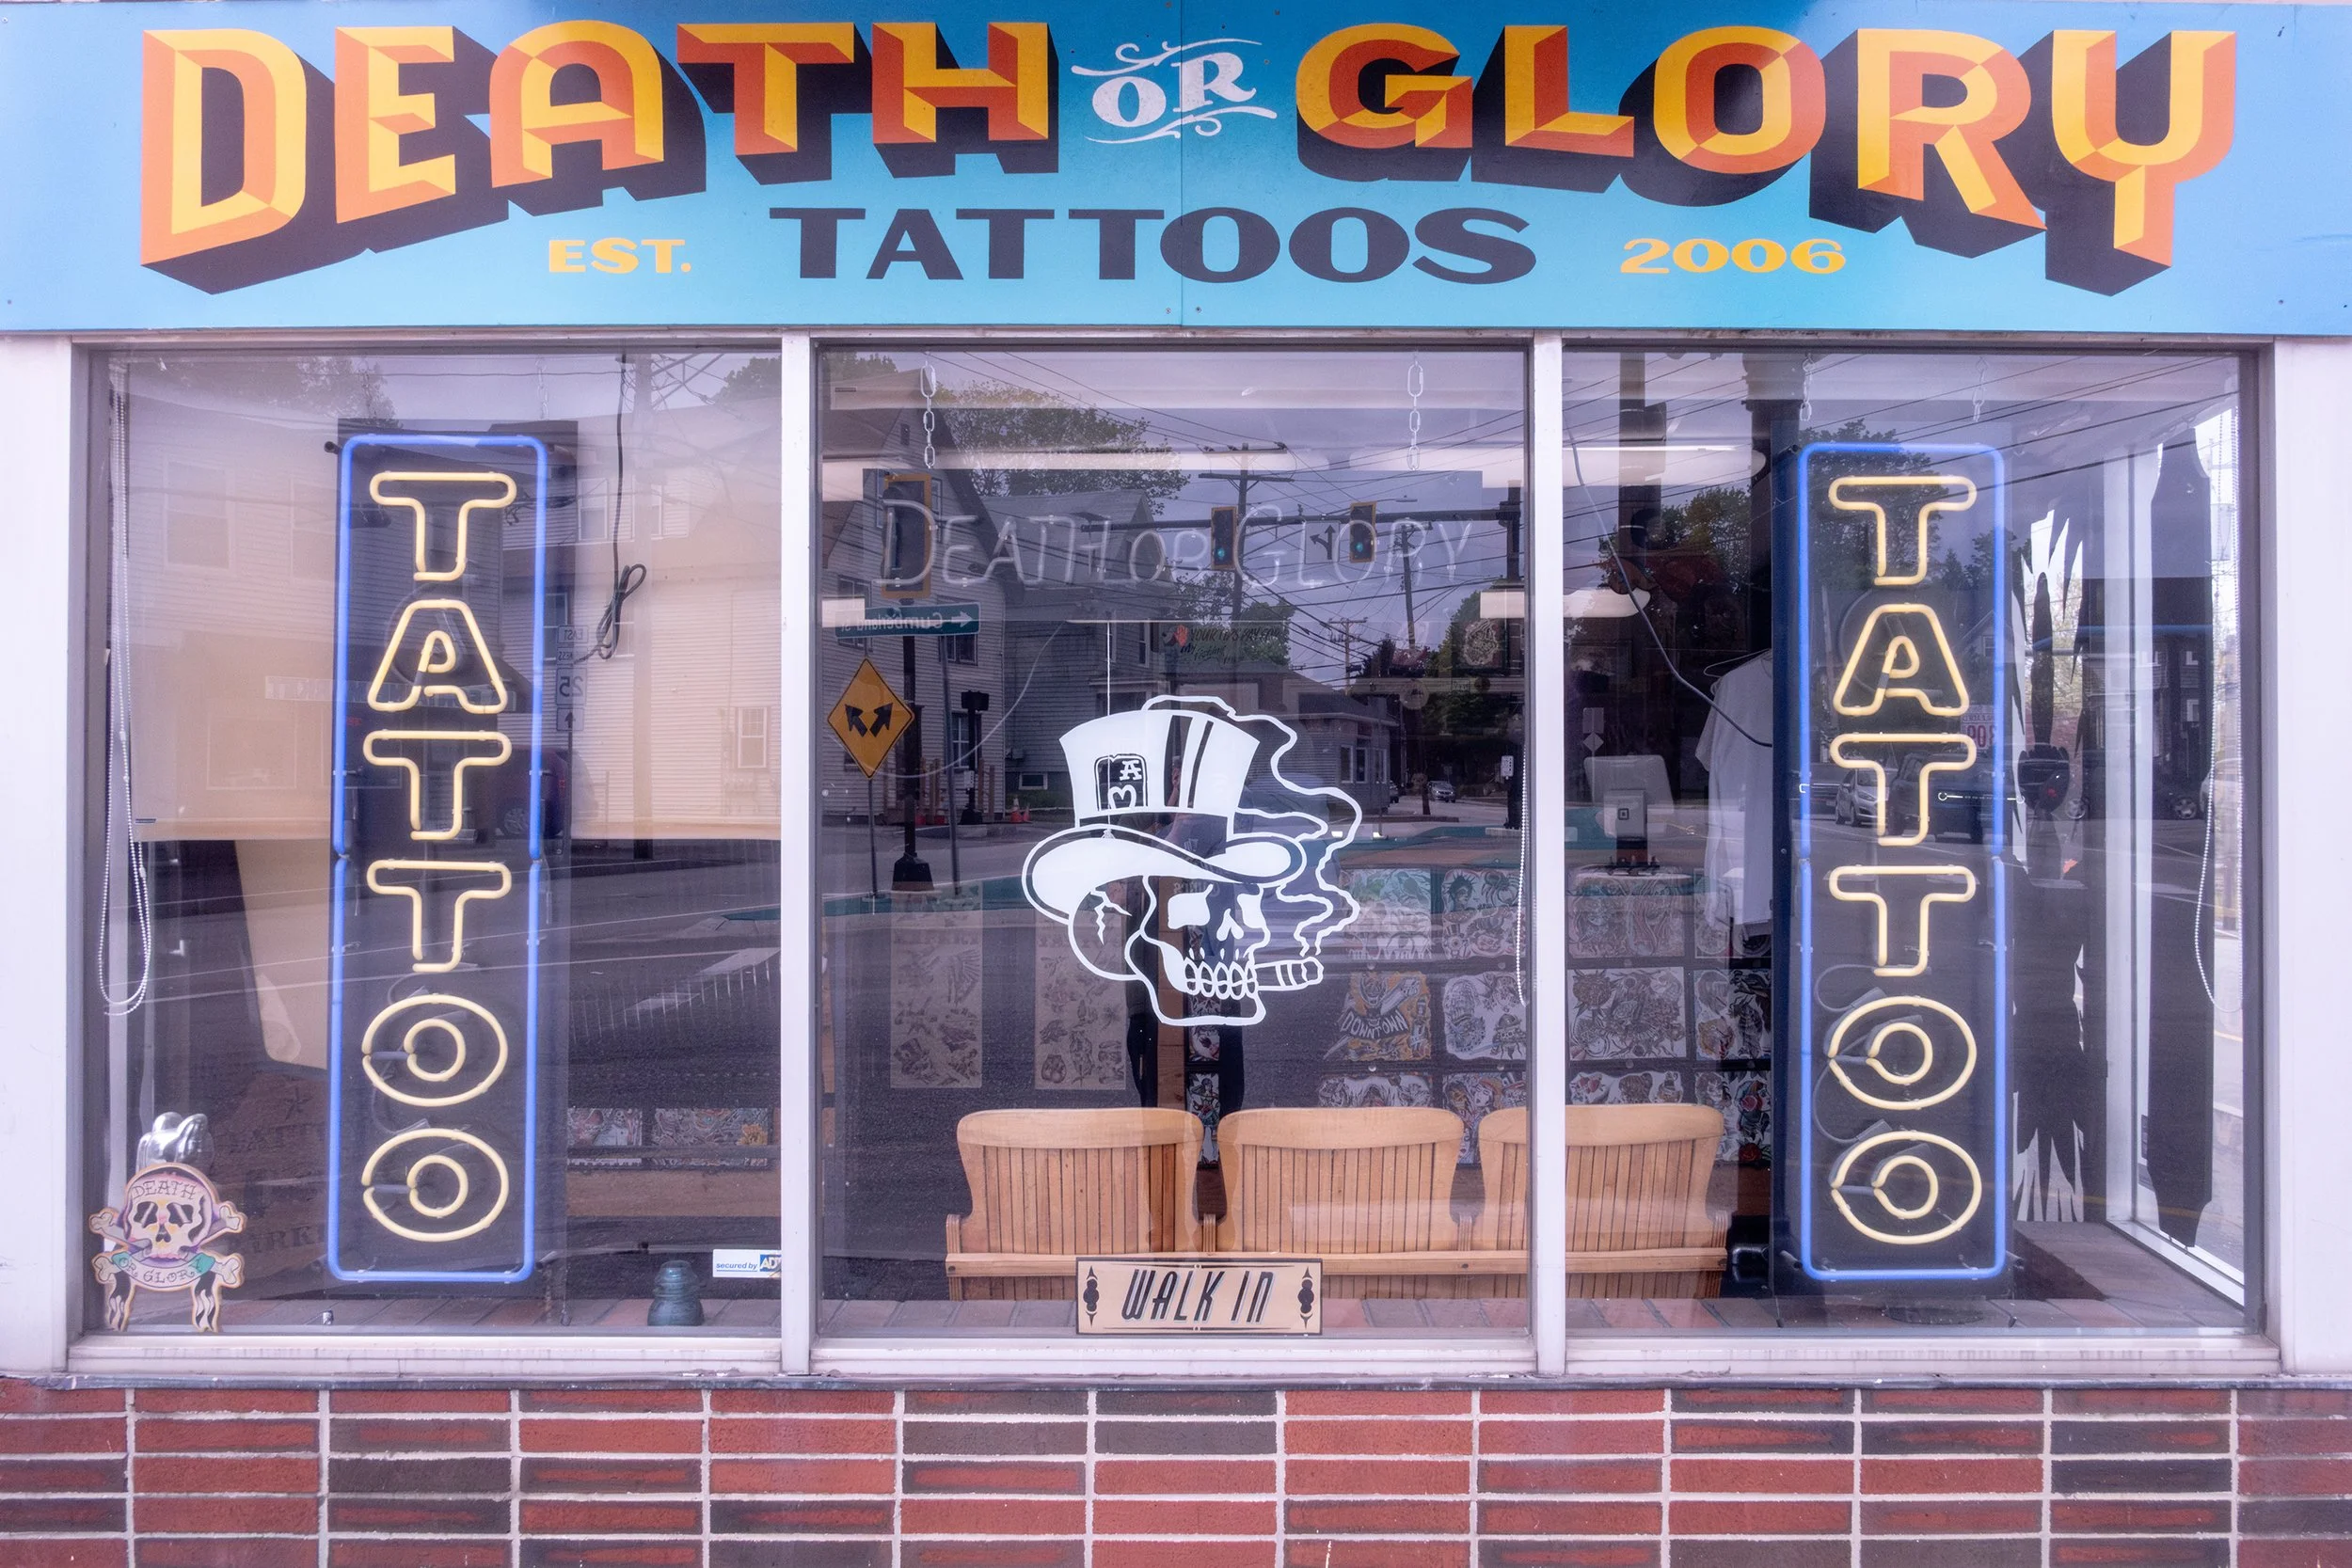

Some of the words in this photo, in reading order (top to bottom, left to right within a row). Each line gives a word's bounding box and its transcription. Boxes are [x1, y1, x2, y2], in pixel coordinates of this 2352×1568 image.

[141, 21, 1049, 273] DEATH
[1089, 49, 1259, 130] OR
[1296, 24, 2236, 275] GLORY
[548, 237, 691, 274] EST.
[770, 206, 1536, 284] TATTOOS
[1620, 237, 1846, 274] 2006
[871, 498, 1113, 587] DEATH
[1233, 504, 1474, 588] GLORY
[361, 470, 517, 1242] TATTOO
[1828, 475, 1982, 1244] TATTOO
[1339, 1008, 1409, 1039] DOWNTOWN
[132, 1180, 197, 1200] DEATH
[119, 1257, 139, 1276] OR
[143, 1258, 203, 1284] GLORY
[1121, 1268, 1226, 1323] WALK
[1231, 1270, 1275, 1324] IN
